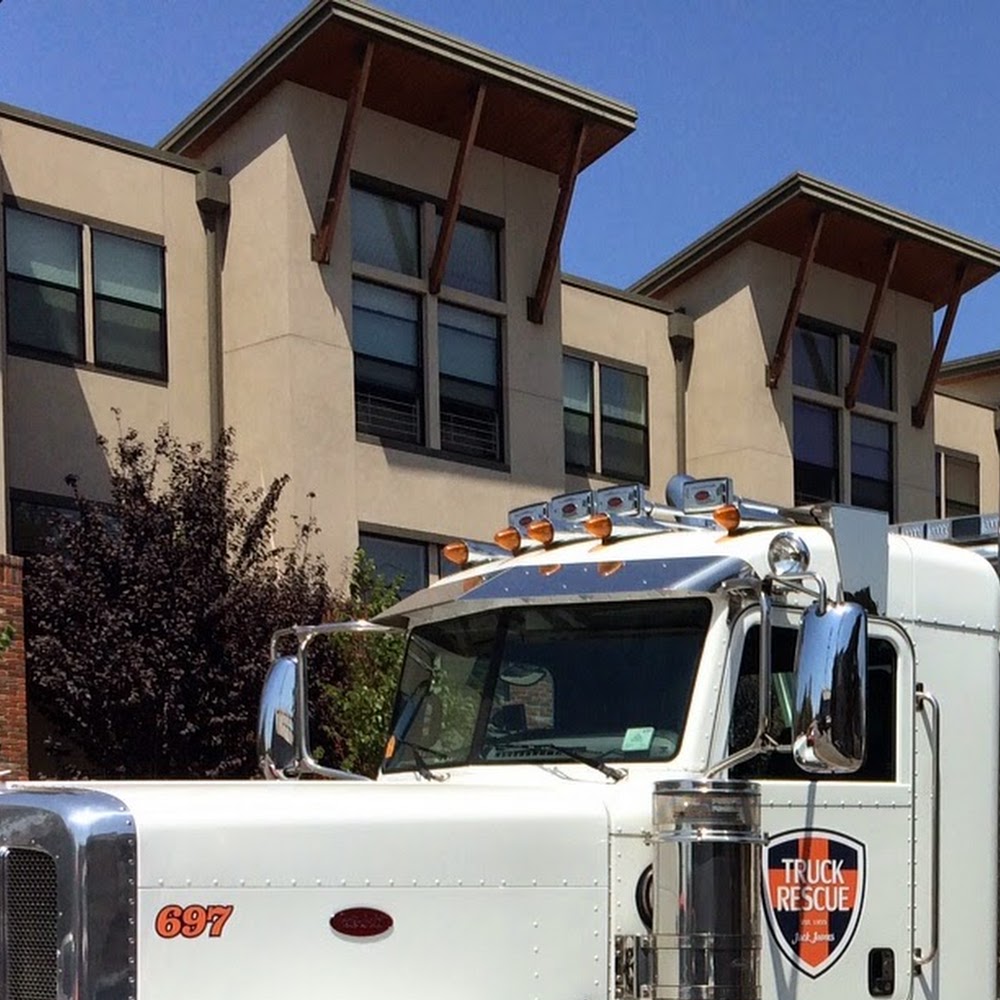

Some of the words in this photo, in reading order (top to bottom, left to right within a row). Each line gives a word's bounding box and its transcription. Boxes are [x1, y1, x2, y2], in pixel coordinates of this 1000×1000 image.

[781, 858, 845, 885] TRUCK
[777, 885, 850, 912] RESCUE
[155, 904, 234, 939] 697
